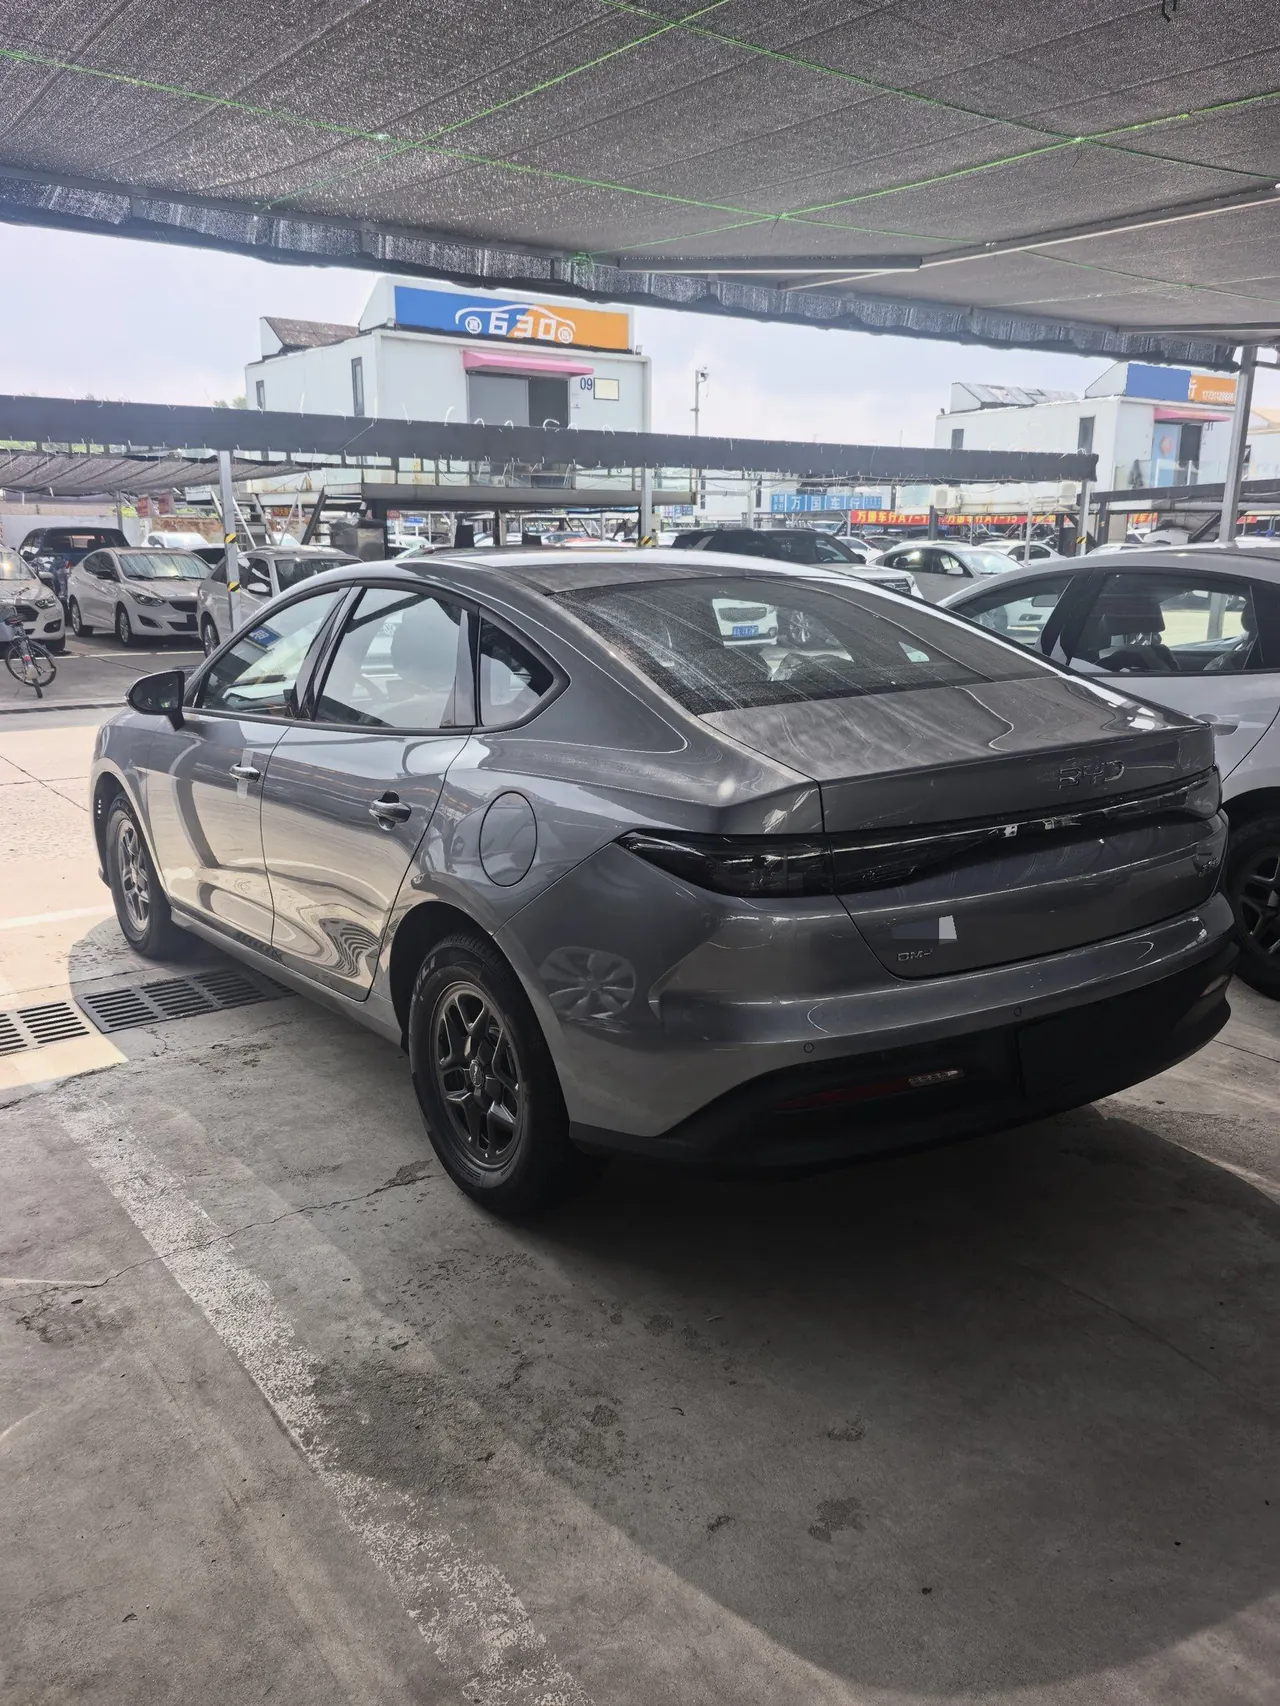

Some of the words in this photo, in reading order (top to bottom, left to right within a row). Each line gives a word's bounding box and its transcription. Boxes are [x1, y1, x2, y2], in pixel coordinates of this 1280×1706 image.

[488, 311, 558, 341] 630
[580, 377, 593, 391] 09
[1058, 759, 1125, 790] BYD
